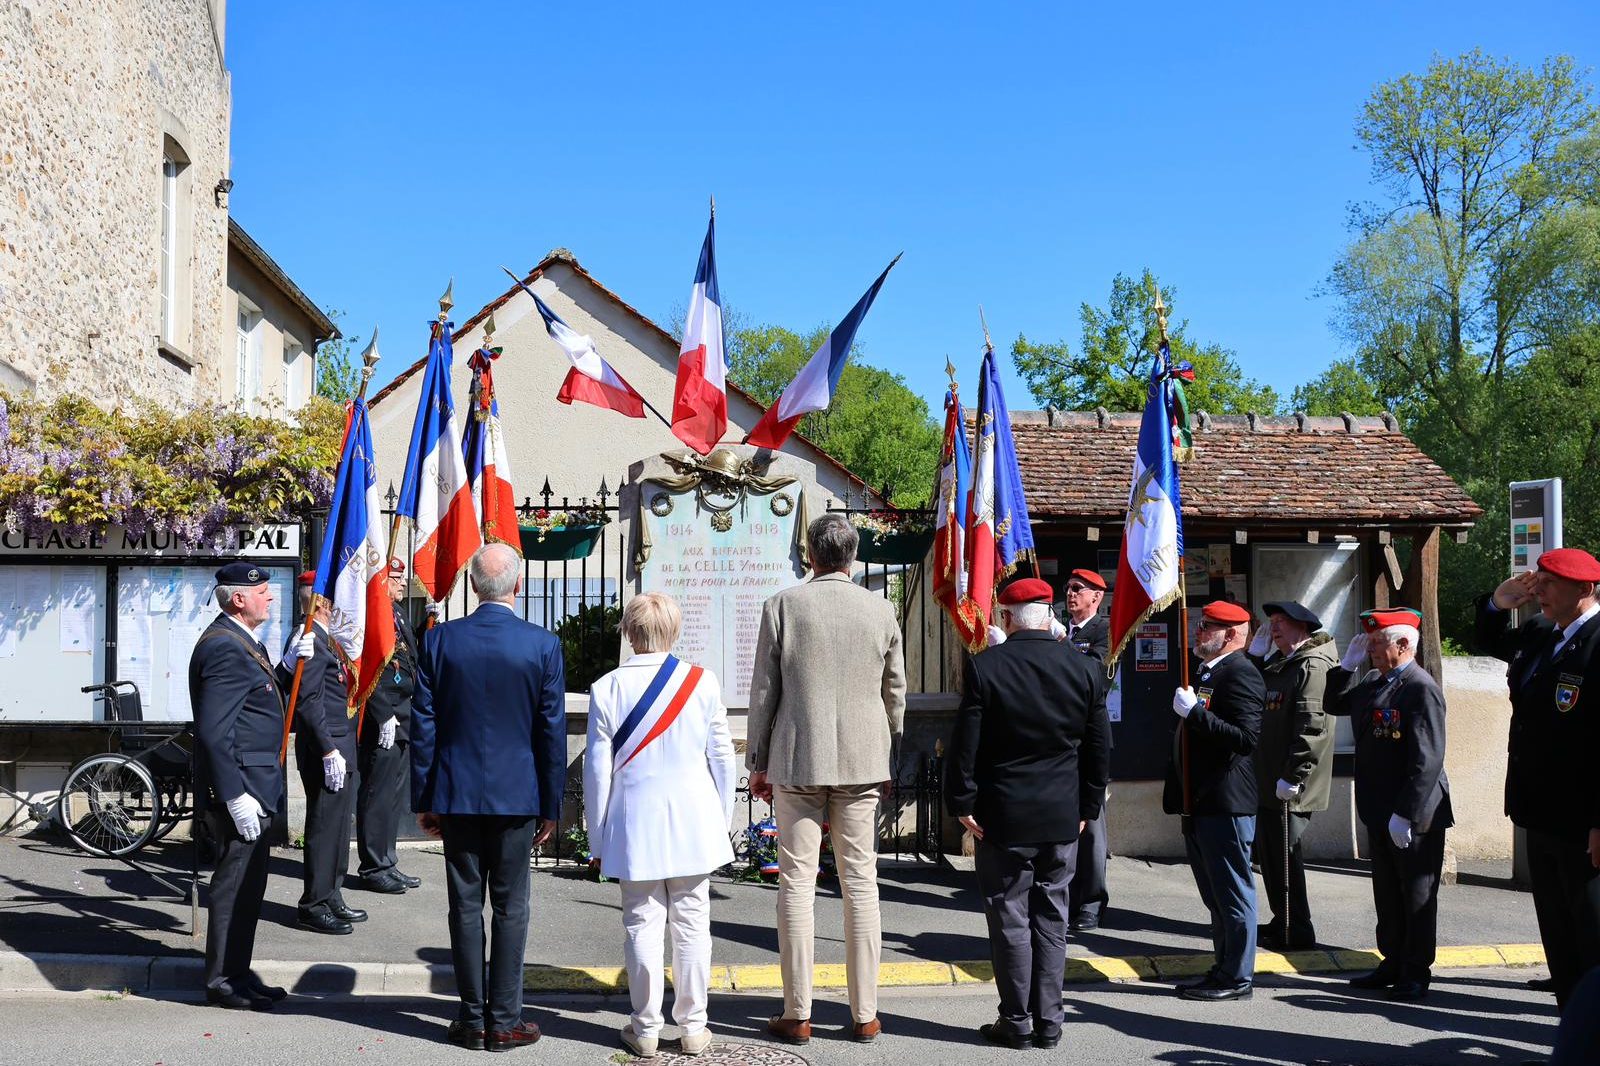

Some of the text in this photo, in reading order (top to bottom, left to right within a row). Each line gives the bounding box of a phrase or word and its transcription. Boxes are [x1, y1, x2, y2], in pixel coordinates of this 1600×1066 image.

[666, 522, 778, 536] 1914 1918
[682, 546, 762, 556] AUX ENFANTS
[661, 563, 674, 573] DE
[678, 563, 691, 573] LA
[695, 559, 735, 572] CELLE
[664, 576, 780, 587] MORTS POUR LA FRANCE
